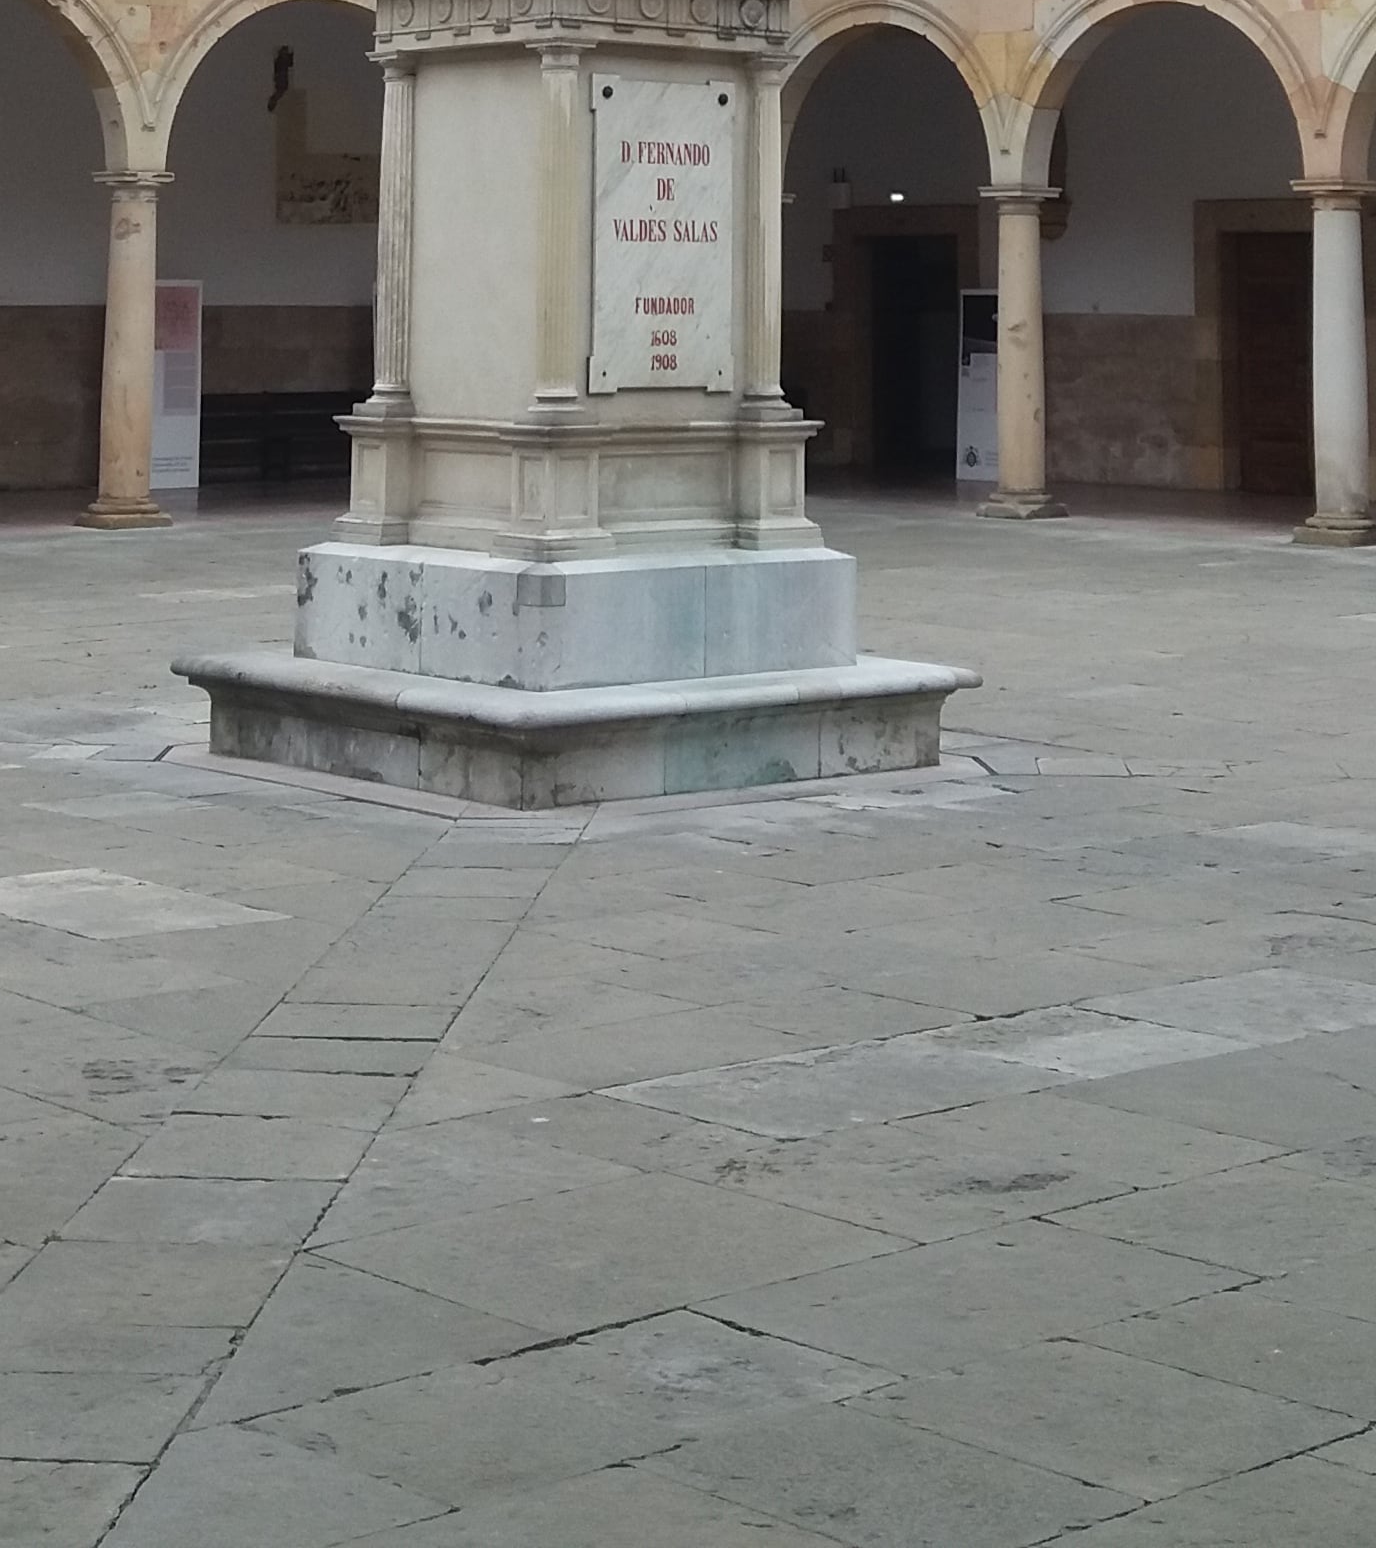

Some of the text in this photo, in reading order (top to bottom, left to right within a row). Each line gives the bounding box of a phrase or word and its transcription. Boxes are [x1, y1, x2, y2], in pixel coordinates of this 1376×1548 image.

[637, 141, 711, 167] FERNANDO
[656, 178, 675, 201] DE
[673, 220, 718, 243] SALAS
[635, 296, 695, 315] FUNDADOR
[650, 329, 678, 347] 1608
[650, 353, 678, 371] 1908
